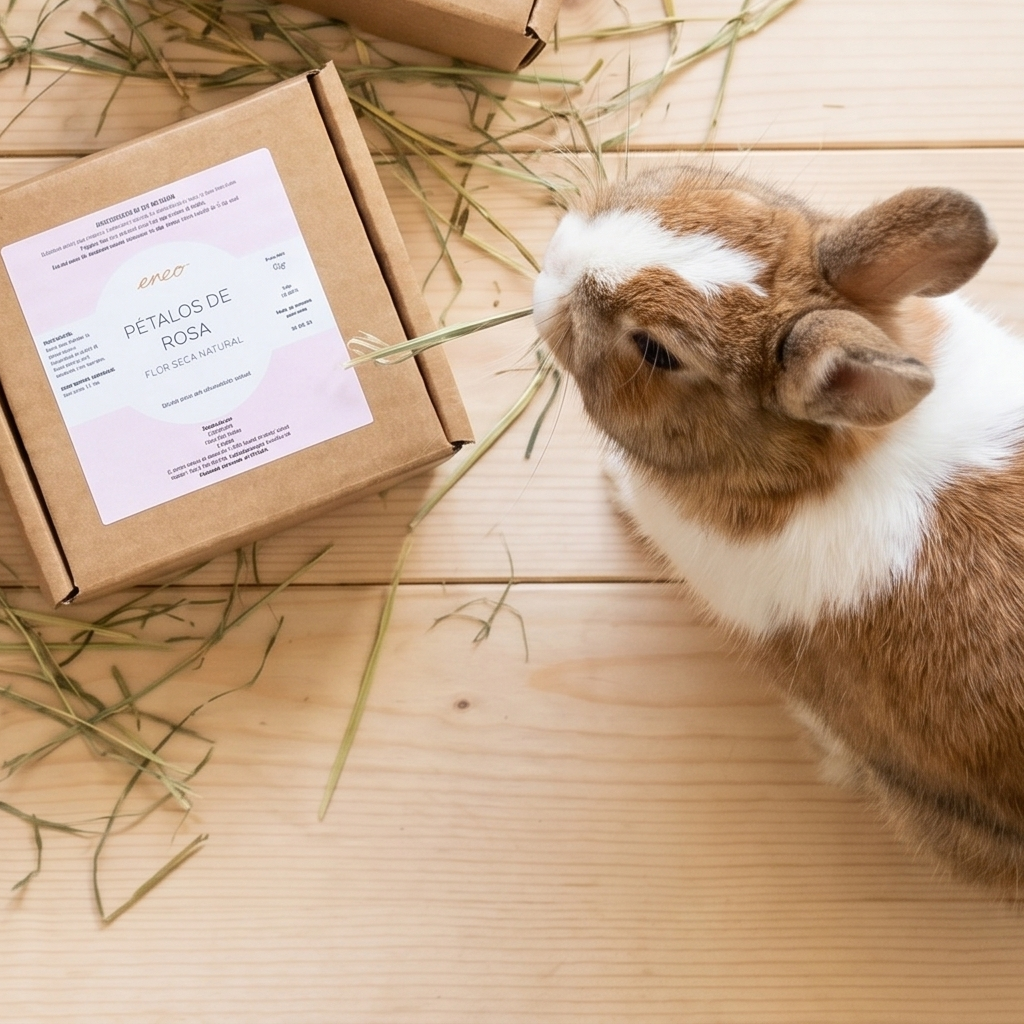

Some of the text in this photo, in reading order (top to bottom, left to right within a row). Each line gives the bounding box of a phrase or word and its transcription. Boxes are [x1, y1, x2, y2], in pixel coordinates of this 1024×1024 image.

[137, 263, 190, 290] eneo
[123, 287, 232, 339] PÉTALOS DE
[161, 322, 212, 351] ROSA
[144, 336, 244, 379] FLOR SECA NATURAL
